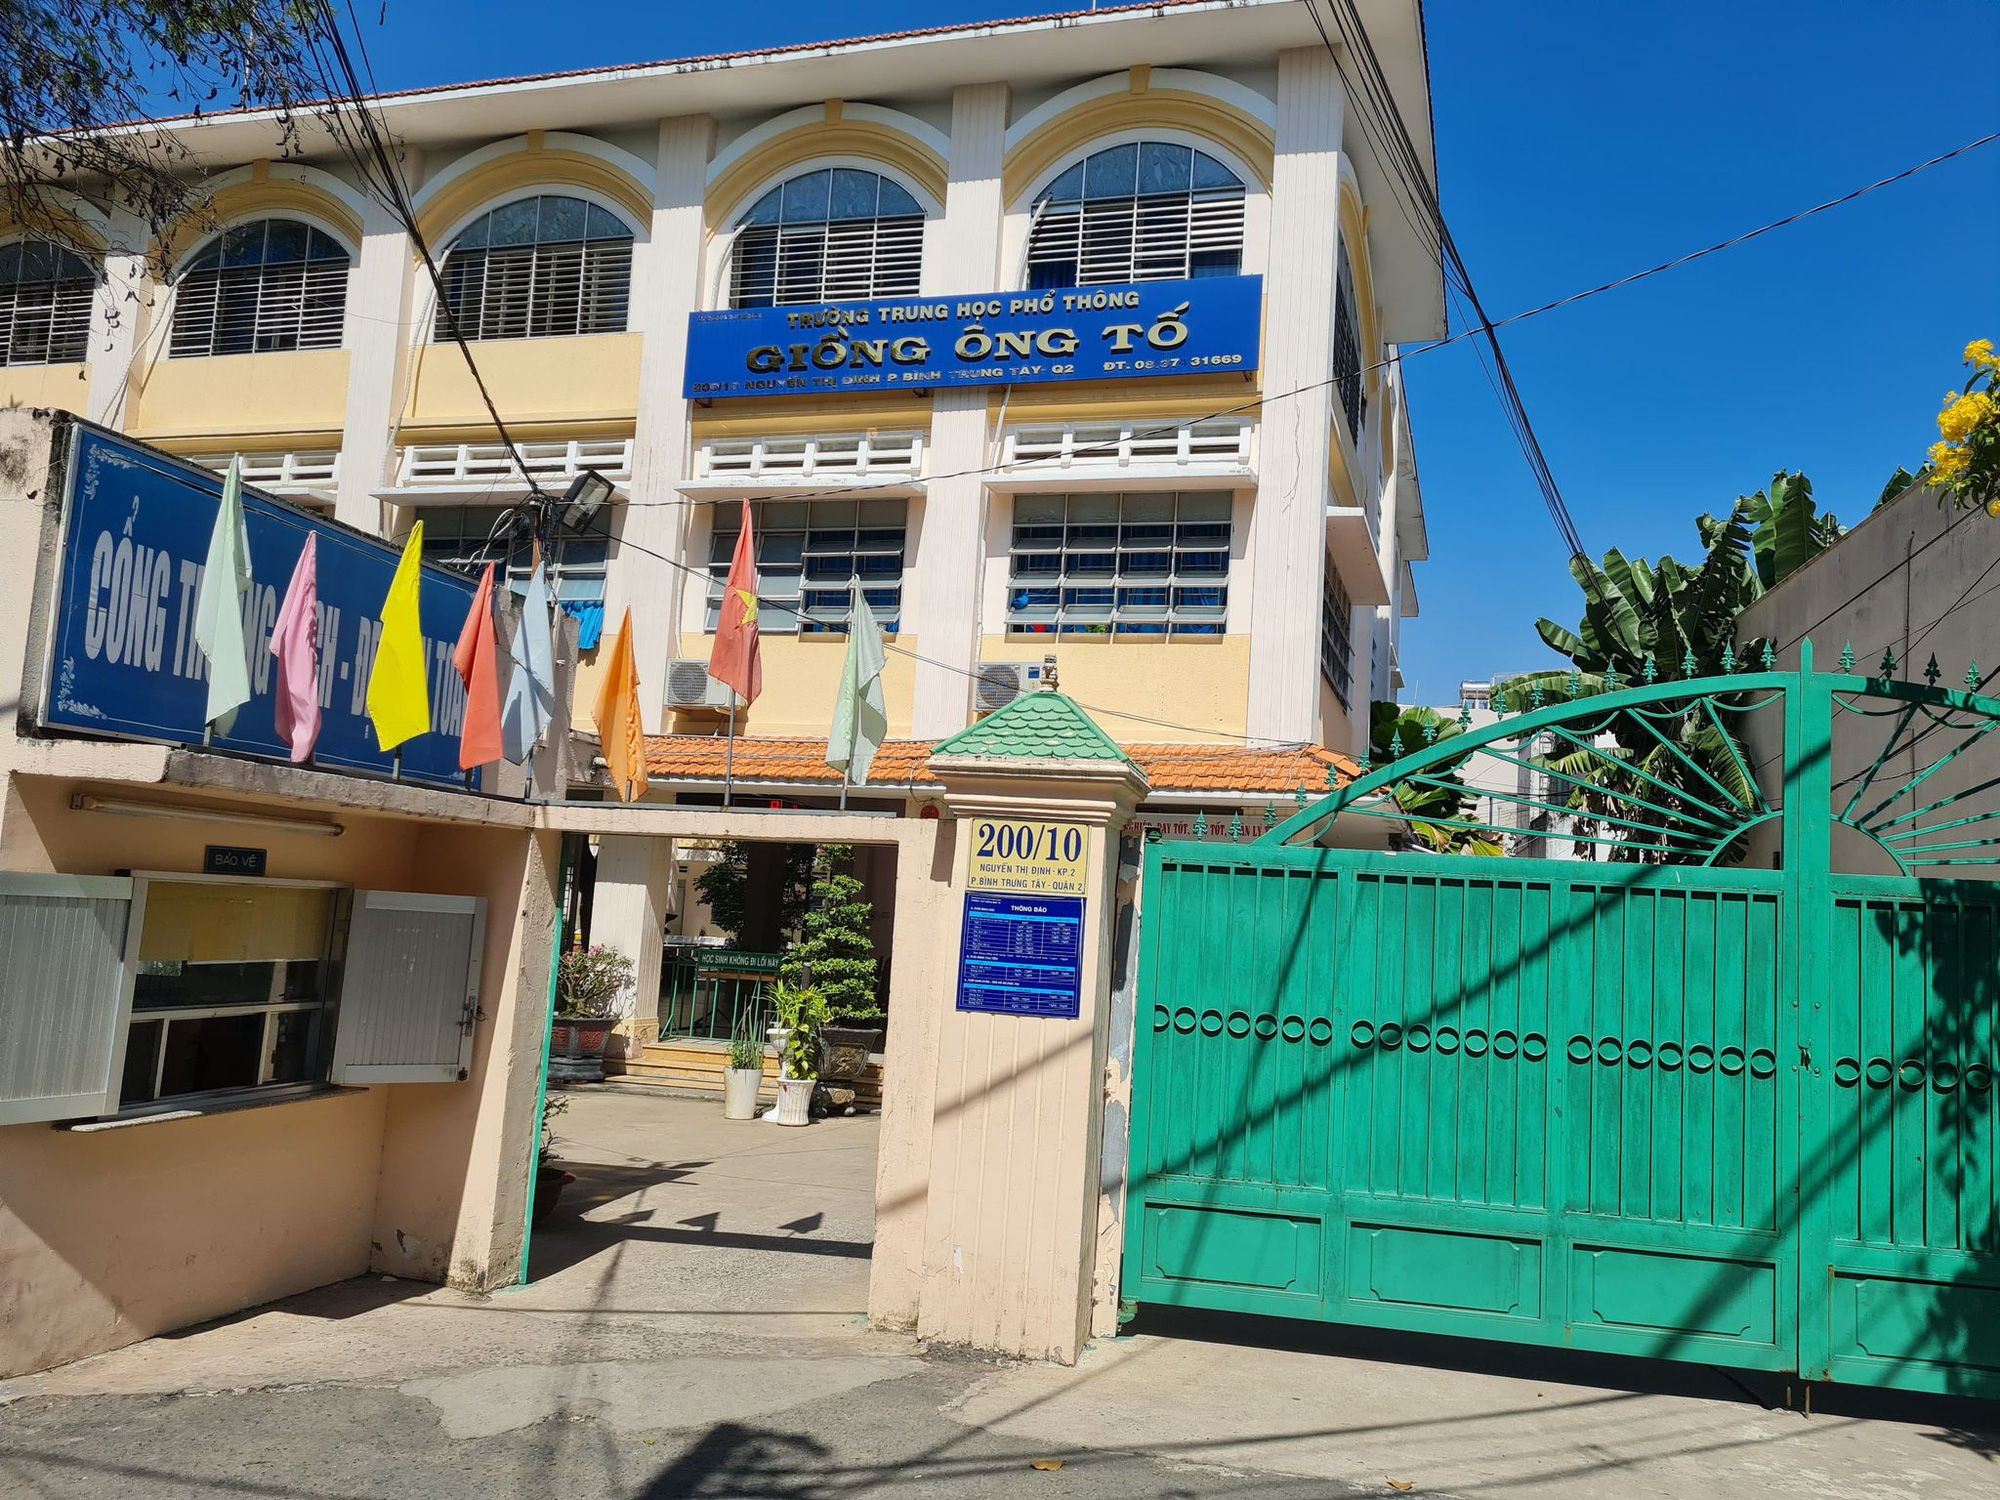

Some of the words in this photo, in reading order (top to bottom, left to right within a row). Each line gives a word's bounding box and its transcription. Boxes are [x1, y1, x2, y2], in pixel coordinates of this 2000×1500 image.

[787, 305, 870, 329] TRƯỜNG
[878, 303, 949, 324] TRUNG
[956, 300, 1002, 323] HỌC
[1009, 289, 1056, 316] PHỔ
[1062, 289, 1140, 313] THÔNG
[746, 325, 931, 374] GIỒNG
[954, 324, 1080, 363] ÔNG
[1101, 300, 1191, 355] TỐ
[1190, 354, 1243, 367] 31669
[1051, 364, 1075, 375] Q2
[85, 495, 171, 673] CỔNG
[173, 559, 277, 696] TRNG
[976, 823, 1083, 862] 200/10
[215, 852, 239, 867] BẢO
[979, 862, 1012, 874] NGUYỄN
[1016, 865, 1029, 876] THỊ
[1031, 865, 1051, 877] ĐỊNH
[1057, 867, 1076, 877] KP.2
[970, 876, 998, 886] P.BÌNH
[1031, 879, 1046, 890] TÂY
[1052, 880, 1075, 893] QUẬN
[1077, 883, 1083, 891] 2
[1010, 904, 1033, 913] THÔNG
[1033, 905, 1048, 913] BÁO
[702, 954, 714, 965] HỌC
[714, 955, 729, 964] SINH
[728, 955, 749, 966] KHÔNG
[757, 955, 767, 967] LỐI
[767, 957, 779, 968] NÀY
